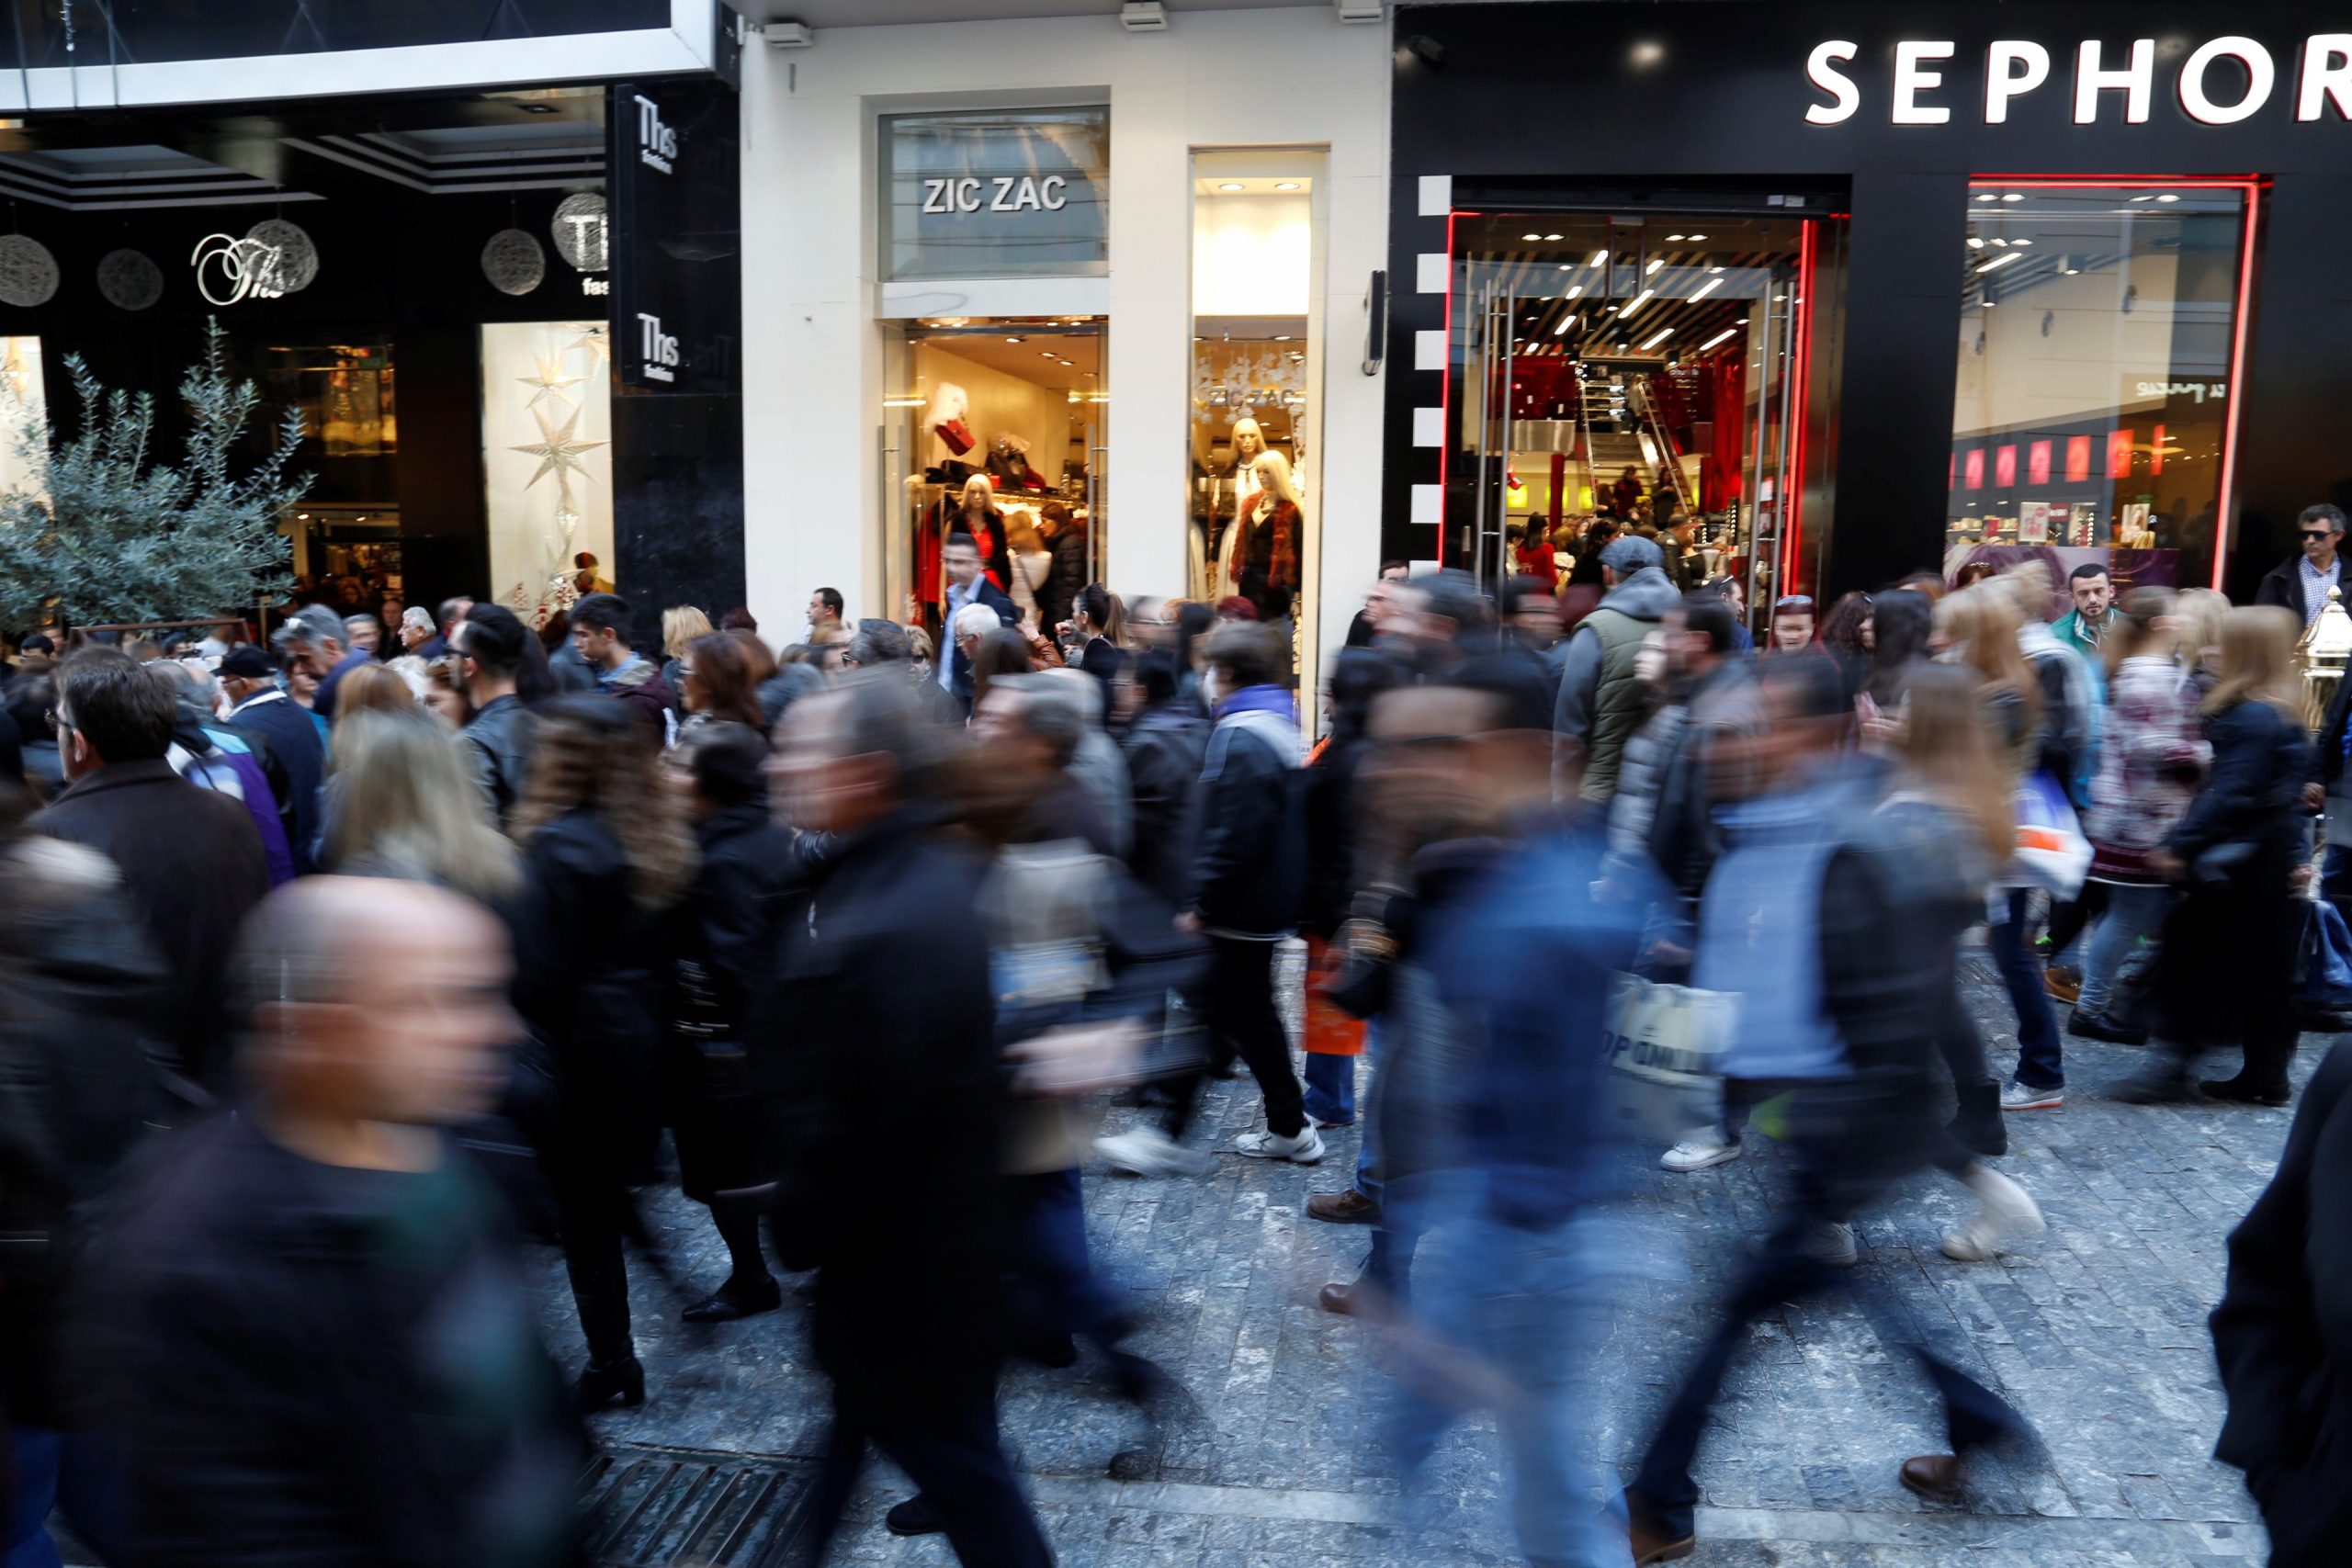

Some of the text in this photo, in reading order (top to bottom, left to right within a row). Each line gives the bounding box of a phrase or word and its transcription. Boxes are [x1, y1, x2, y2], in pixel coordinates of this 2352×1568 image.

[634, 95, 678, 159] Ths
[923, 175, 1067, 213] ZIC ZAC
[637, 312, 679, 367] Ths
[1209, 389, 1295, 407] ZIC ZAC
